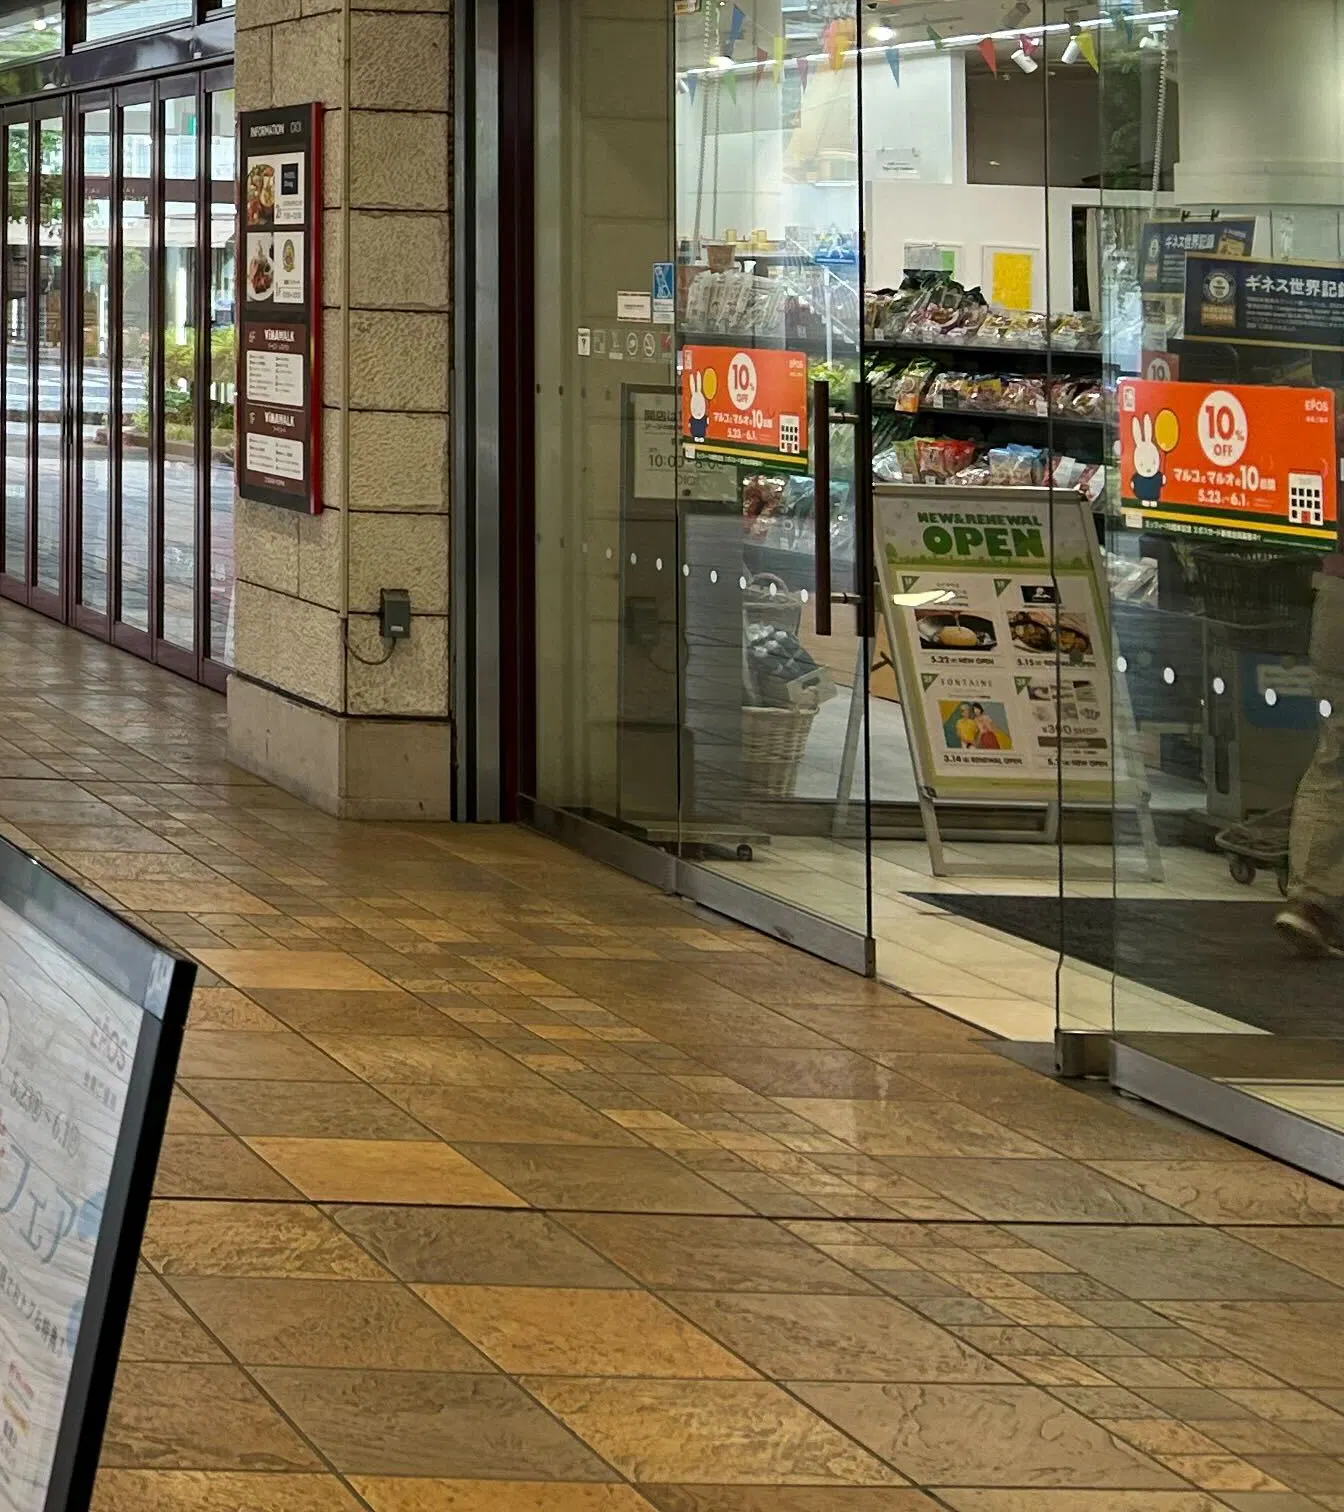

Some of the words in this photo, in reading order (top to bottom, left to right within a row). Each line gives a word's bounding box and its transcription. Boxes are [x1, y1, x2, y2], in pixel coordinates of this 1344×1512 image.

[250, 122, 285, 138] INFORMATION
[1164, 234, 1215, 249] ギネス世界記録
[1304, 398, 1329, 412] EPOS
[1213, 444, 1233, 457] OFF
[917, 511, 1043, 527] NEW&RENEWAL
[922, 525, 1046, 558] OPEN
